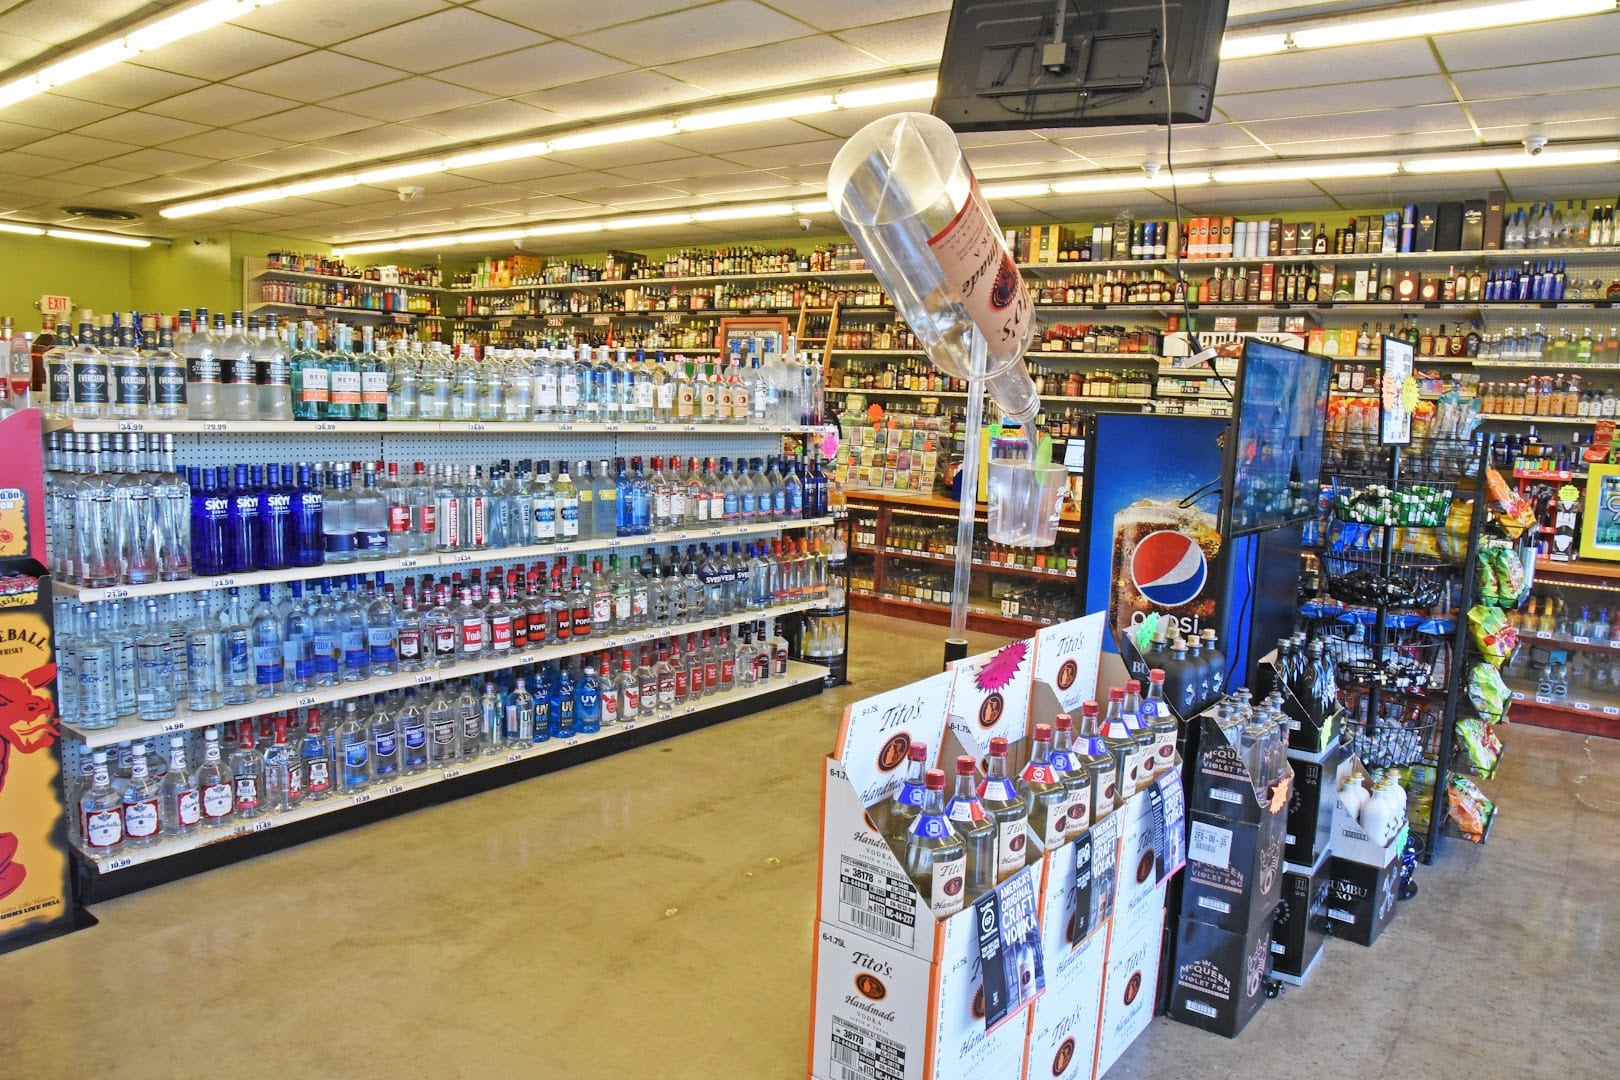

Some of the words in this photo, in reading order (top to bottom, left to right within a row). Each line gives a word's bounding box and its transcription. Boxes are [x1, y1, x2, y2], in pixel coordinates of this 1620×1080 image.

[48, 297, 67, 310] EXIT
[121, 423, 143, 431] 34.99
[705, 576, 721, 584] SVED
[530, 624, 546, 632] POPO
[559, 621, 569, 629] POP
[465, 631, 481, 641] Vodk
[496, 630, 510, 640] Vodk
[516, 629, 526, 637] POP
[561, 700, 574, 711] UV
[582, 695, 597, 703] UV
[535, 704, 548, 715] UV
[879, 697, 924, 733] Tito's
[1203, 750, 1242, 761] McQUE
[829, 768, 849, 781] 6-1.7
[1203, 761, 1234, 773] VIOLET
[1237, 767, 1249, 775] FO
[853, 831, 892, 852] Handm
[866, 848, 892, 861] VODKA
[110, 858, 131, 870] 10.99
[940, 862, 963, 877] Tito'
[852, 868, 874, 883] 38178
[1192, 870, 1222, 883] VIOLET
[1225, 878, 1243, 888] FOG
[1000, 871, 1031, 899] AMERICA'S
[1001, 884, 1033, 911] ORIGINAL
[1335, 891, 1352, 901] XO
[0, 910, 24, 920] URNS
[42, 899, 61, 909] HELL
[1002, 896, 1034, 929] CRAFT
[1003, 917, 1037, 947] VODKA
[822, 932, 847, 949] 6-1.75L
[852, 951, 893, 978] Tito's
[1180, 965, 1231, 988] McQUEEN
[1180, 974, 1209, 988] VIOLET
[1212, 983, 1230, 994] FOG
[844, 994, 896, 1023] Handmade
[856, 1010, 882, 1027] VODKA
[843, 1028, 864, 1046] 38178
